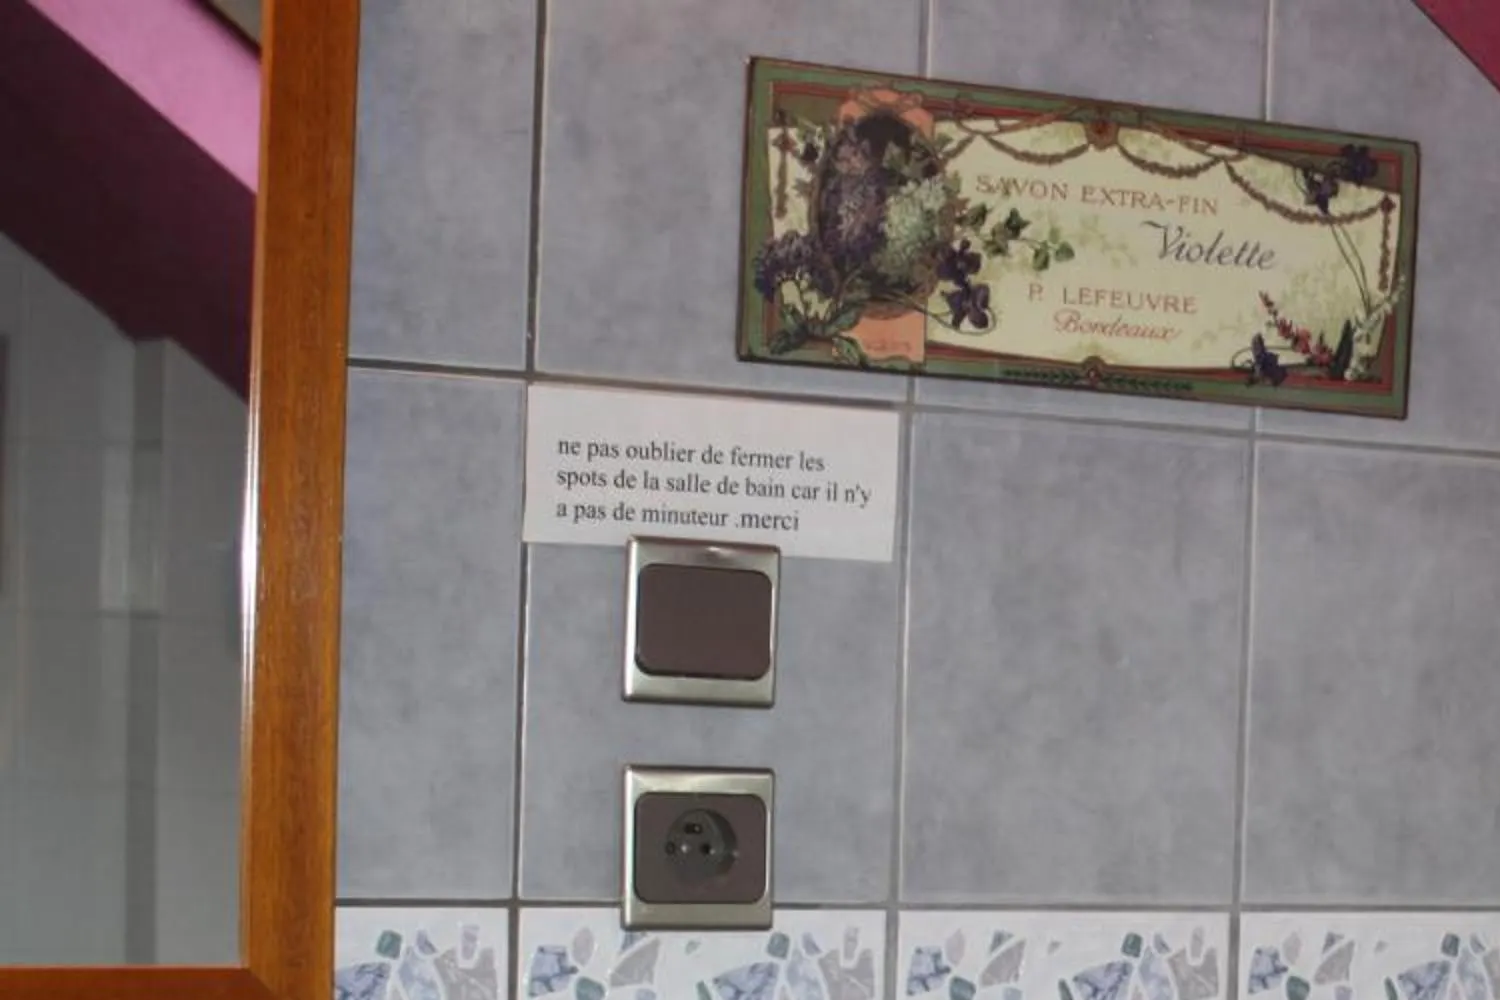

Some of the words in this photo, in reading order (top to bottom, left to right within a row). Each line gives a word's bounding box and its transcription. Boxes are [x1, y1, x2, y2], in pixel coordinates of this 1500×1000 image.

[976, 175, 1068, 201] SAVON
[1081, 185, 1218, 216] EXTRA-FIN
[1140, 220, 1276, 271] Violette
[1062, 287, 1198, 314] LEFEUVRE
[1053, 308, 1181, 341] Bordeaux
[558, 439, 581, 456] ne
[587, 441, 620, 462] pas
[625, 440, 696, 463] oublier
[701, 444, 724, 464] de
[730, 445, 794, 470] fermer
[800, 451, 825, 472] les
[557, 469, 607, 490] spots
[613, 469, 637, 489] de
[643, 470, 660, 491] la
[666, 473, 711, 493] salle
[717, 475, 739, 495] de
[745, 477, 785, 498] bain
[791, 485, 820, 501] car
[826, 481, 838, 502] il
[845, 482, 872, 508] n'y
[556, 502, 567, 518] a
[574, 503, 606, 524] pas
[613, 501, 635, 521] de
[641, 503, 730, 527] minuteur
